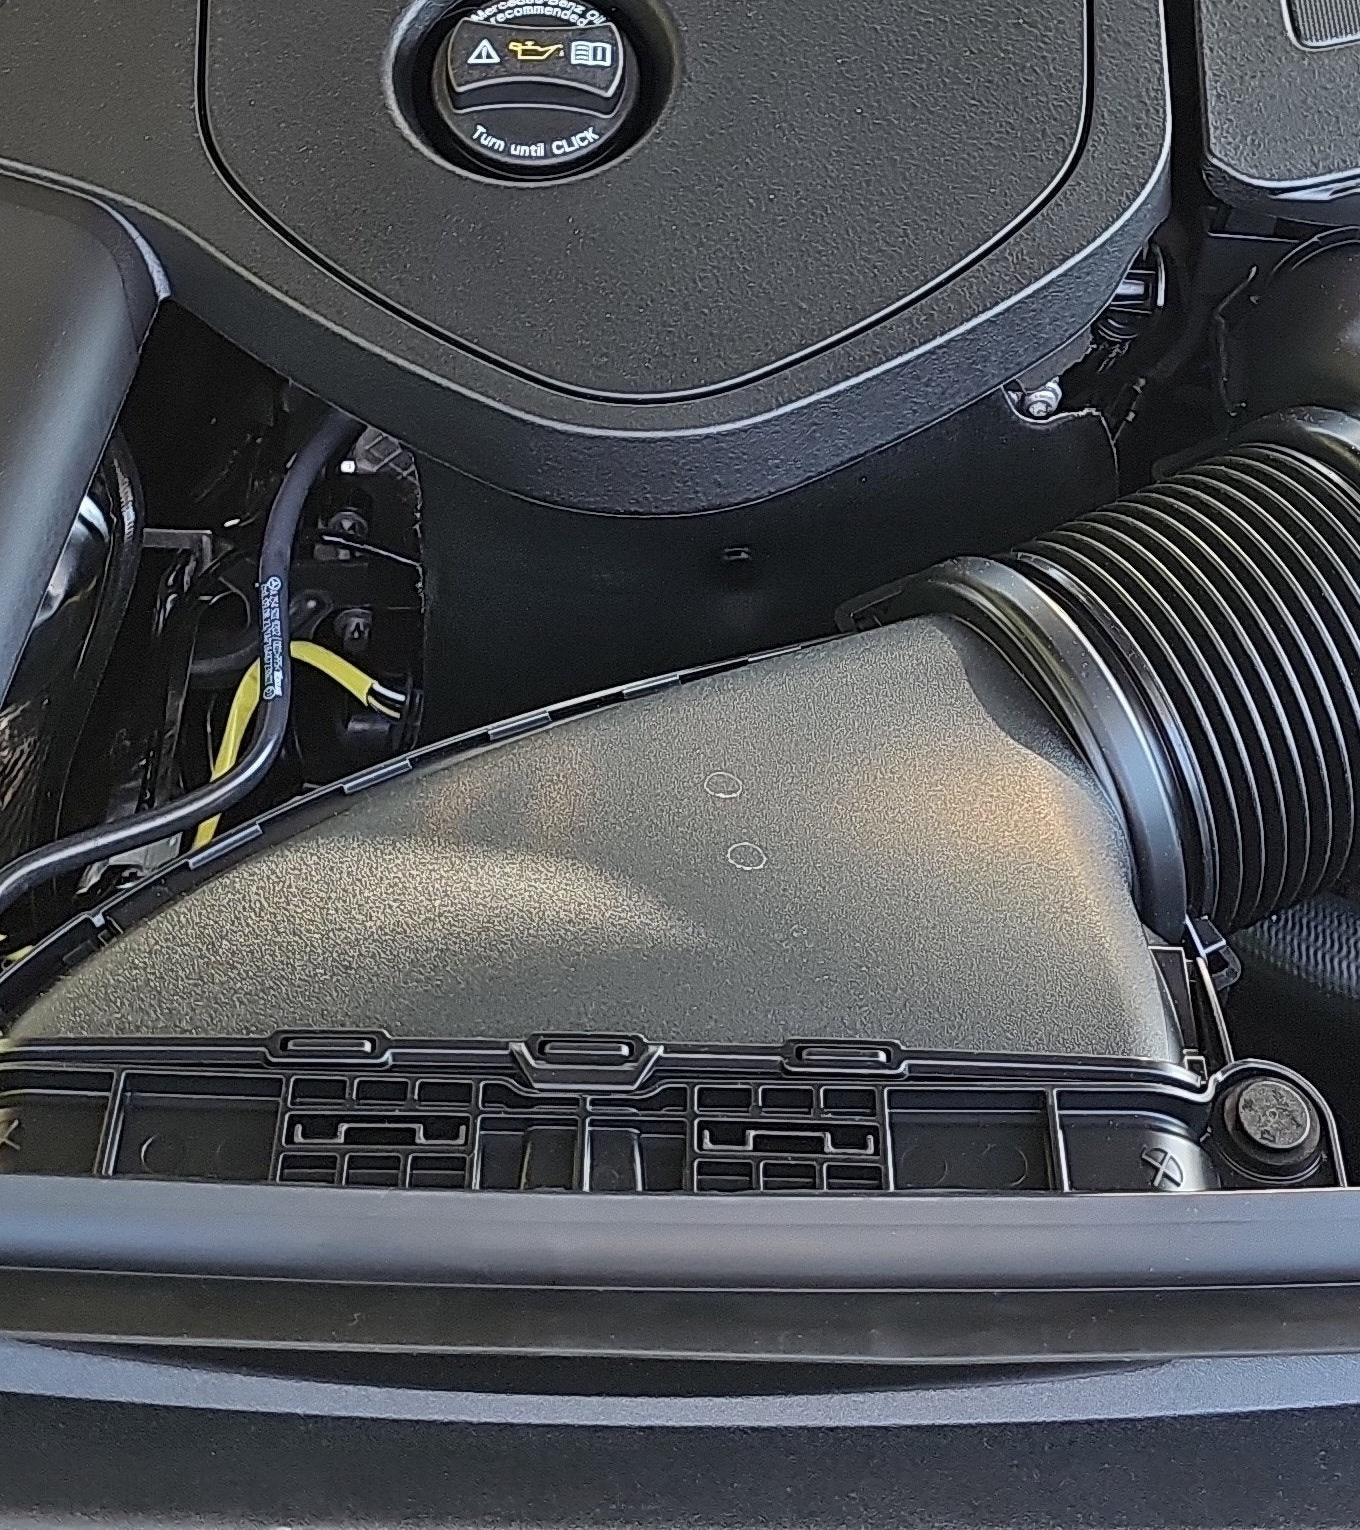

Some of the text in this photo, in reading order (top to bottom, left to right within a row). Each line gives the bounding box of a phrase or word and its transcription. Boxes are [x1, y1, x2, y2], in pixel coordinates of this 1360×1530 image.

[490, 5, 589, 27] recommended
[586, 10, 607, 25] Oil
[472, 124, 600, 157] Turn until CLICK
